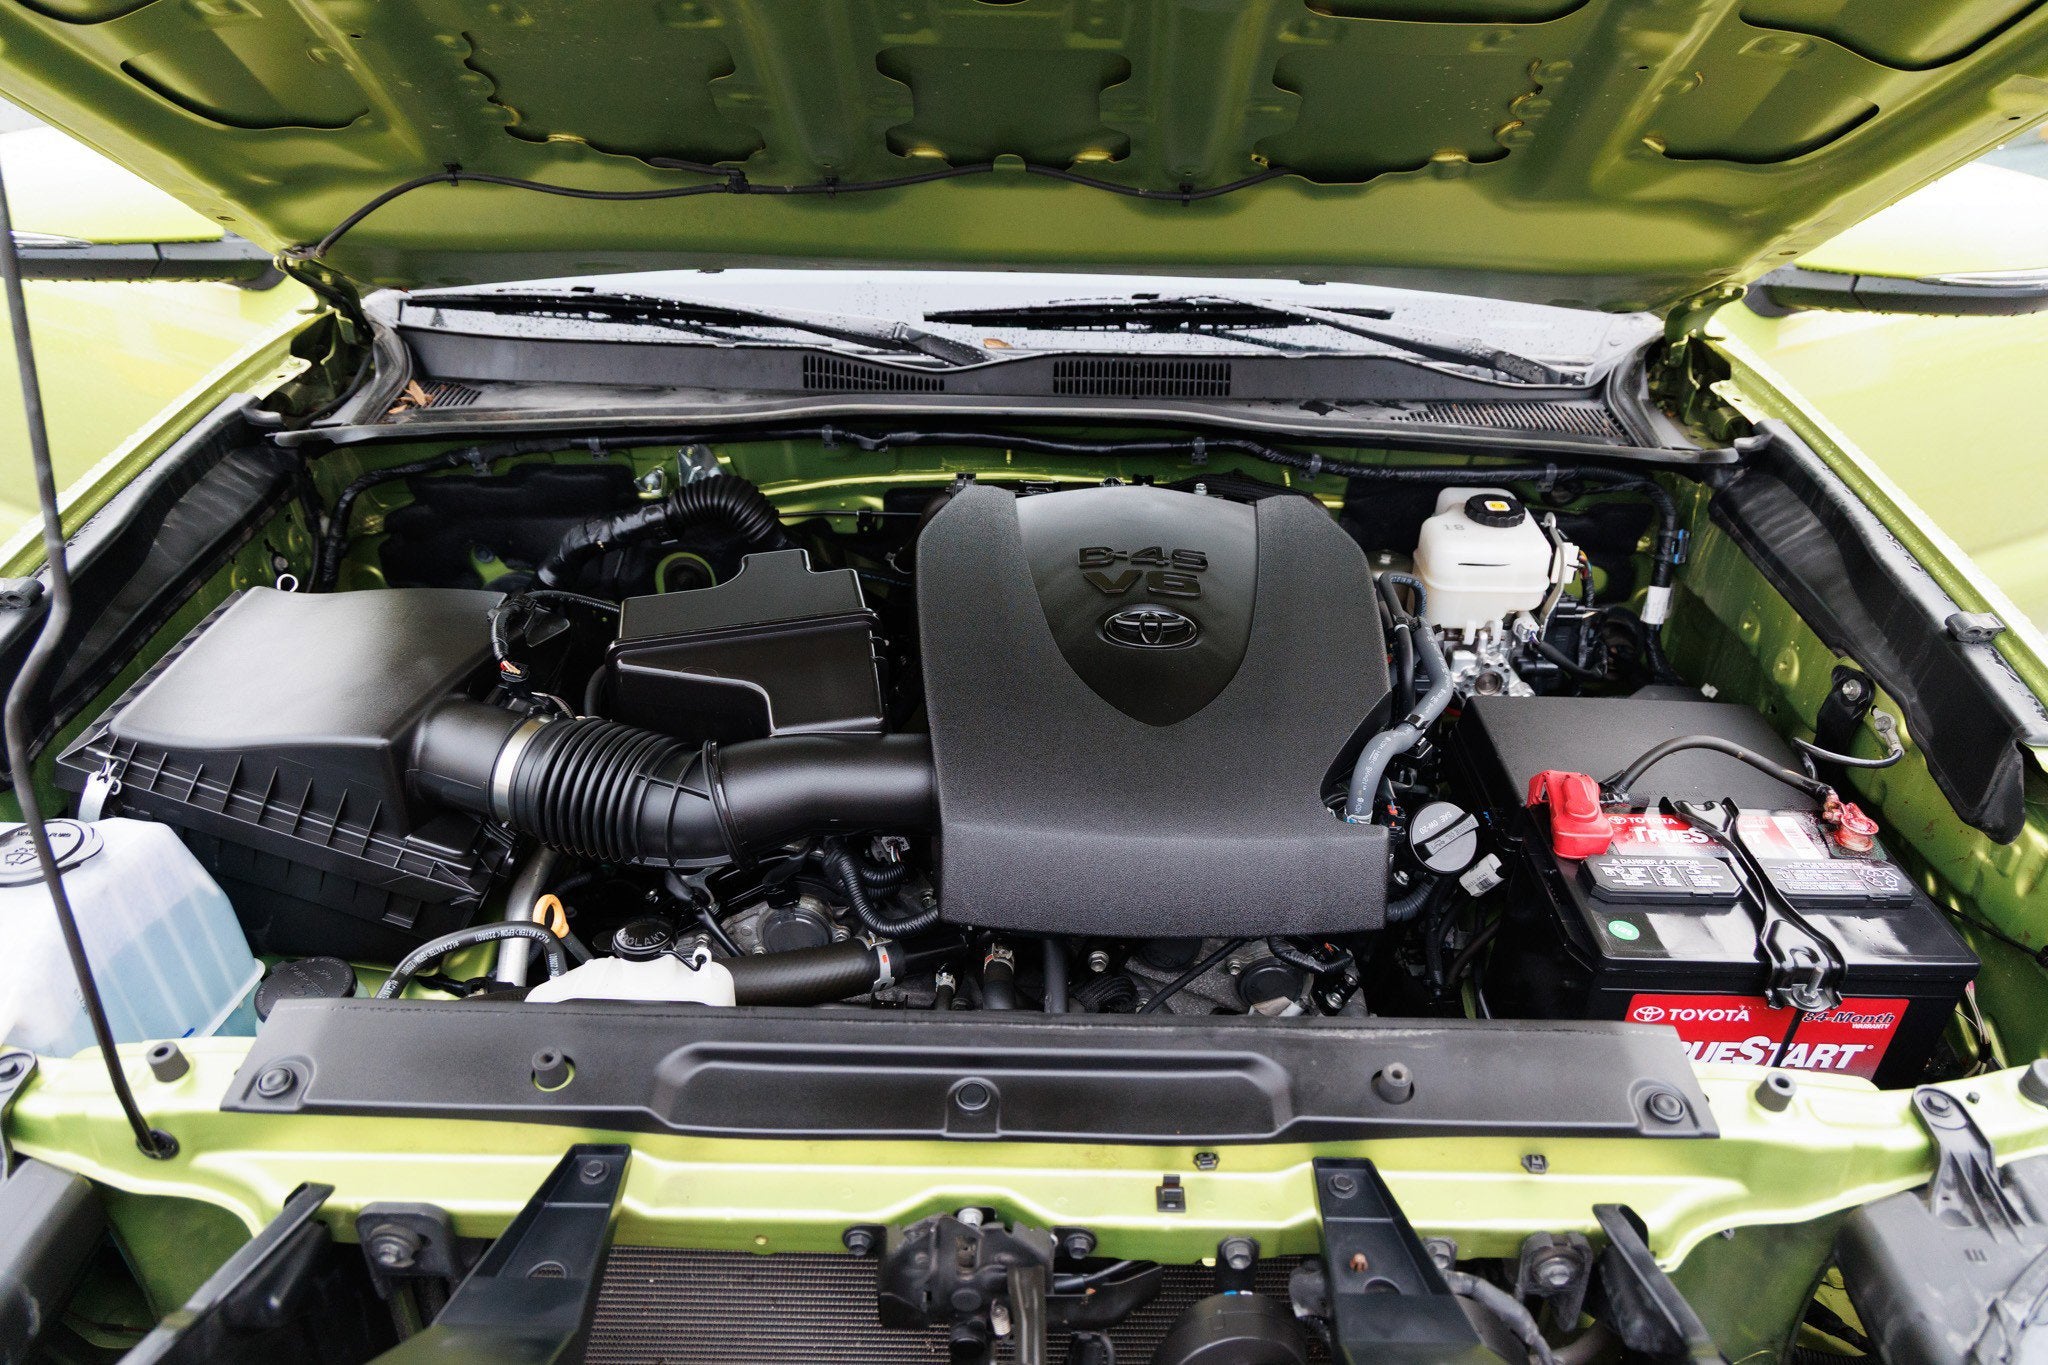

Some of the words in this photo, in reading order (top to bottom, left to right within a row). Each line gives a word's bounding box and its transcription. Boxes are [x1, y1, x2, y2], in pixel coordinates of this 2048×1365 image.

[1078, 546, 1208, 571] D-4S
[1082, 569, 1201, 596] V6
[1439, 811, 1453, 823] SAE
[1627, 816, 1678, 825] TOYOTA
[1418, 819, 1439, 835] 0W-20
[1668, 1008, 1750, 1021] TOYOTA
[1802, 1011, 1896, 1024] 84-Month
